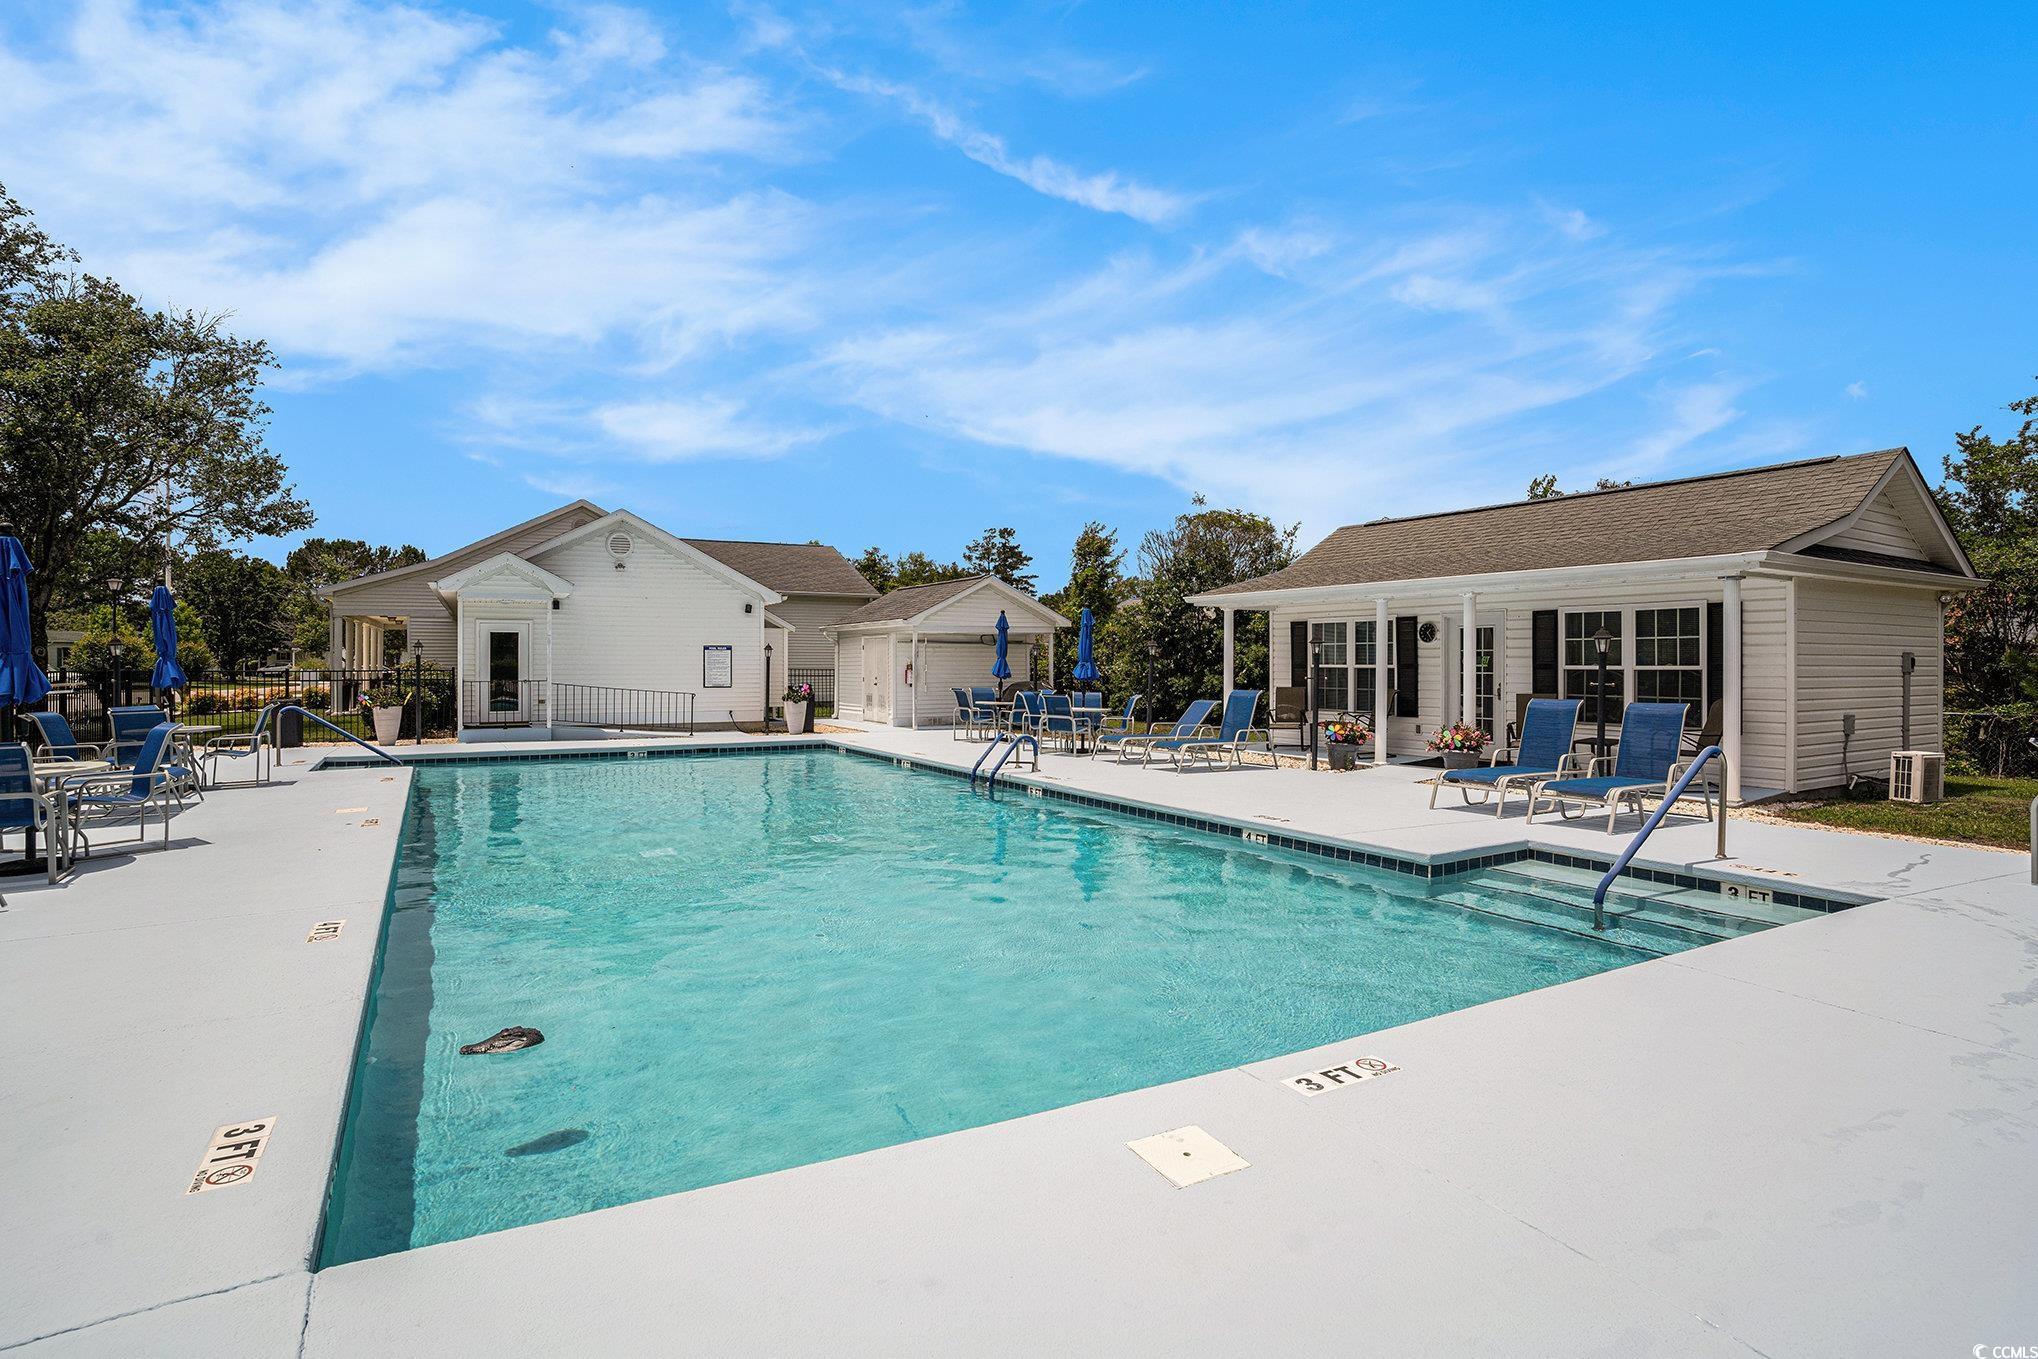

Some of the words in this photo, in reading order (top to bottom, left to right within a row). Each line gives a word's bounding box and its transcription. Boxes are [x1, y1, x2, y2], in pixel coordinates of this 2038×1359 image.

[1728, 886, 1739, 897] 3
[1748, 890, 1769, 902] FT
[1295, 1078, 1324, 1091] 3
[1319, 1065, 1363, 1084] FT
[223, 1124, 266, 1138] 3
[210, 1139, 261, 1163] FT
